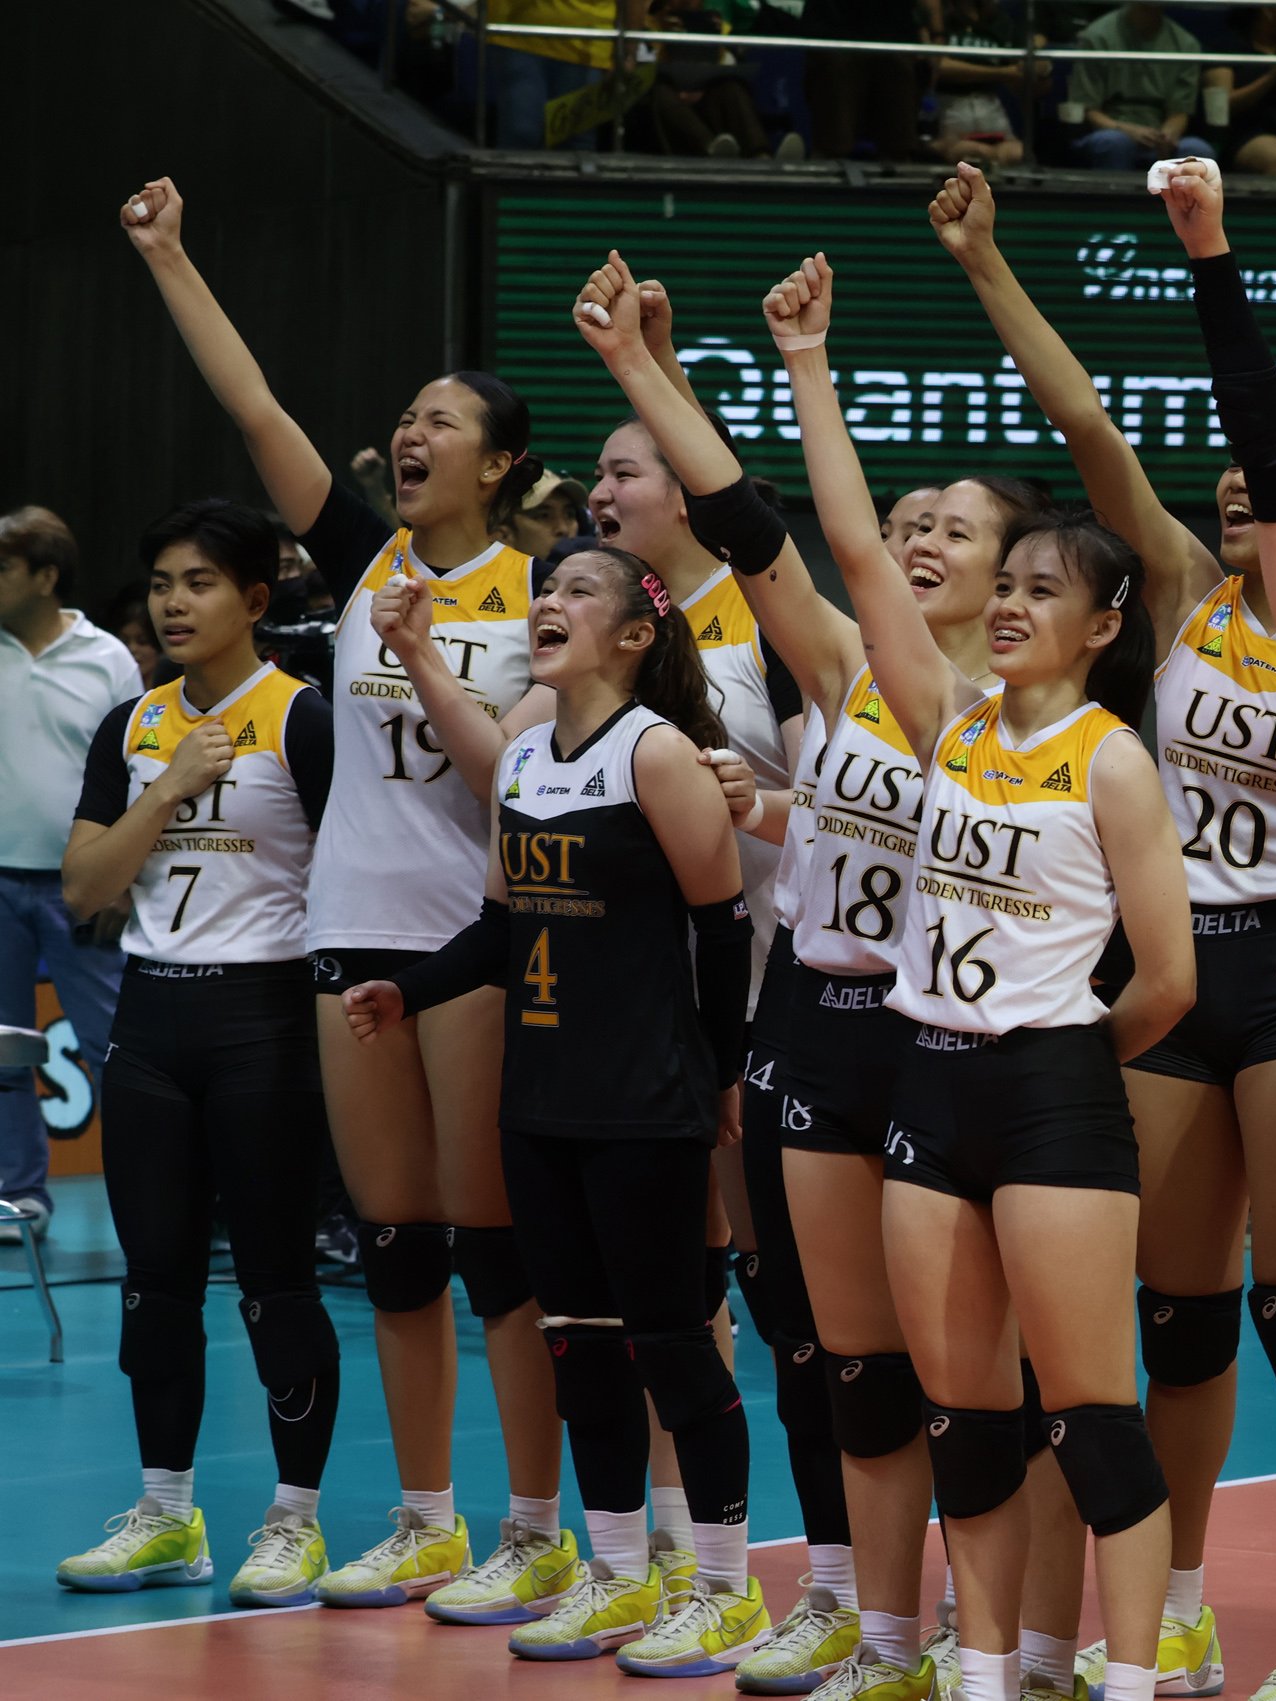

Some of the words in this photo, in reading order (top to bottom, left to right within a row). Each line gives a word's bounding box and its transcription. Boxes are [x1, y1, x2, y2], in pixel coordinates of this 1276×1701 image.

[677, 337, 1228, 449] Quantm
[432, 597, 458, 606] ATEM
[477, 604, 506, 614] DELTA
[349, 681, 413, 701] GOLDEN
[379, 713, 453, 783] 19
[1164, 747, 1222, 778] GOLDEN
[546, 786, 571, 795] DATEM
[580, 786, 606, 797] DELTA
[1039, 780, 1072, 793] DELTA
[869, 828, 915, 859] TIGRE
[930, 806, 1041, 880] UST
[1180, 785, 1269, 871] 20
[187, 837, 255, 853] TIGRESSES
[501, 832, 585, 883] UST
[167, 865, 202, 933] 7
[821, 851, 903, 943] 18
[967, 887, 1053, 921] TIGRESSES
[1192, 908, 1262, 936] DELTA
[523, 926, 558, 1005] 4
[921, 915, 998, 1004] 16
[723, 1500, 745, 1512] COMP
